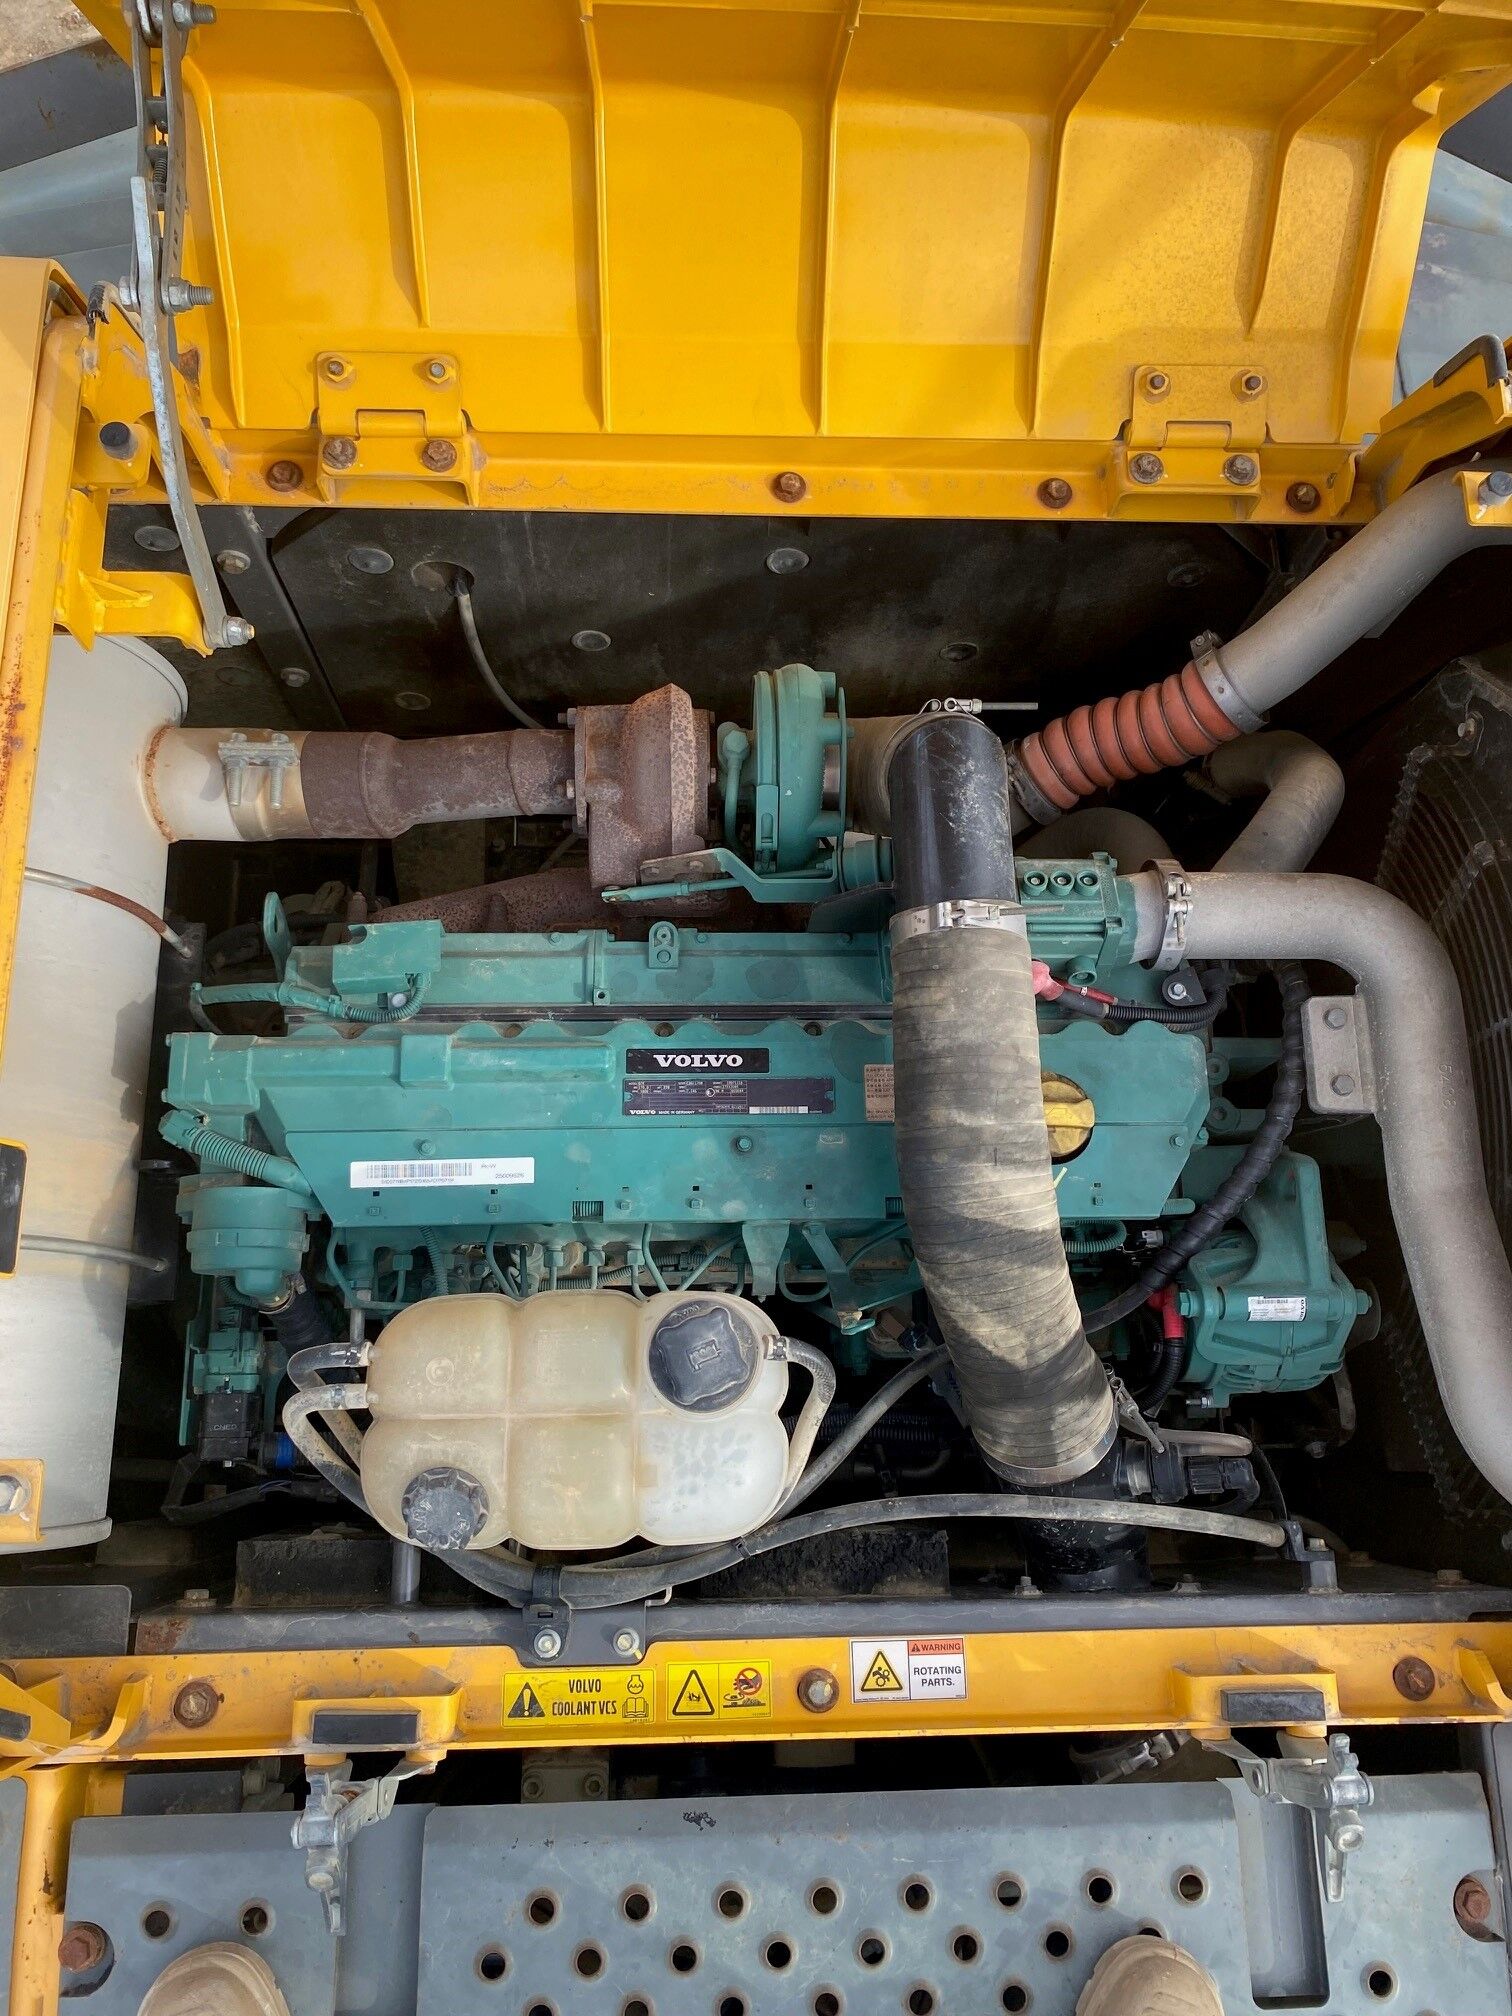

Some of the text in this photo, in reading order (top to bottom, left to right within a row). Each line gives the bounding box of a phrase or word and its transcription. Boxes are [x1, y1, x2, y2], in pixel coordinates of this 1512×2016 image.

[653, 1054, 743, 1067] VOLVO
[921, 1643, 960, 1651] WARNING
[913, 1665, 962, 1676] ROTATING
[569, 1679, 601, 1693] VOLVO
[921, 1678, 955, 1687] PARTS.
[552, 1700, 617, 1716] COOLANT VCS
